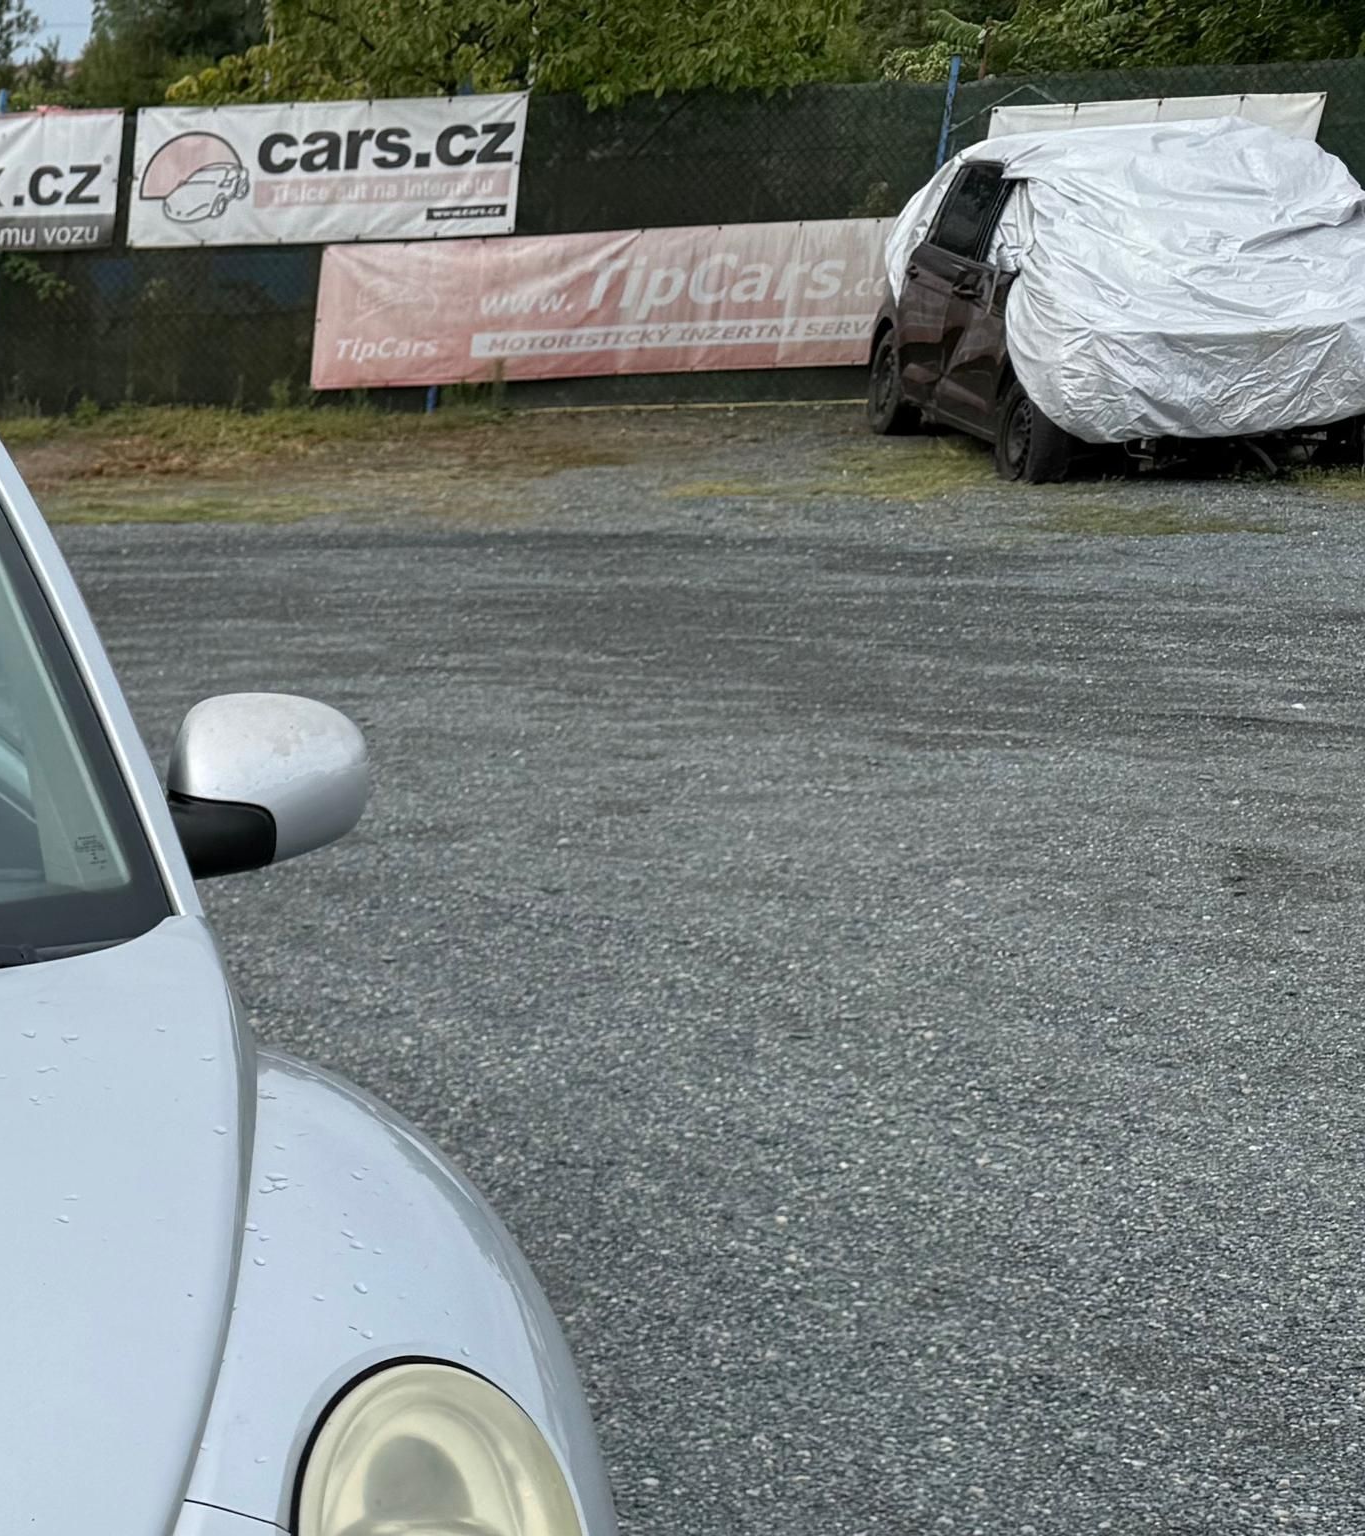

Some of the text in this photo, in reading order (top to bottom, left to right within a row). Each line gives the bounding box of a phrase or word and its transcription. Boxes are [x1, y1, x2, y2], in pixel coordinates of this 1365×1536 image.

[257, 121, 516, 174] cars.cz
[44, 225, 100, 245] vozu
[336, 337, 439, 363] TipCars
[488, 318, 872, 353] MOTORISTICKÝ INZERTNÍ SERV
